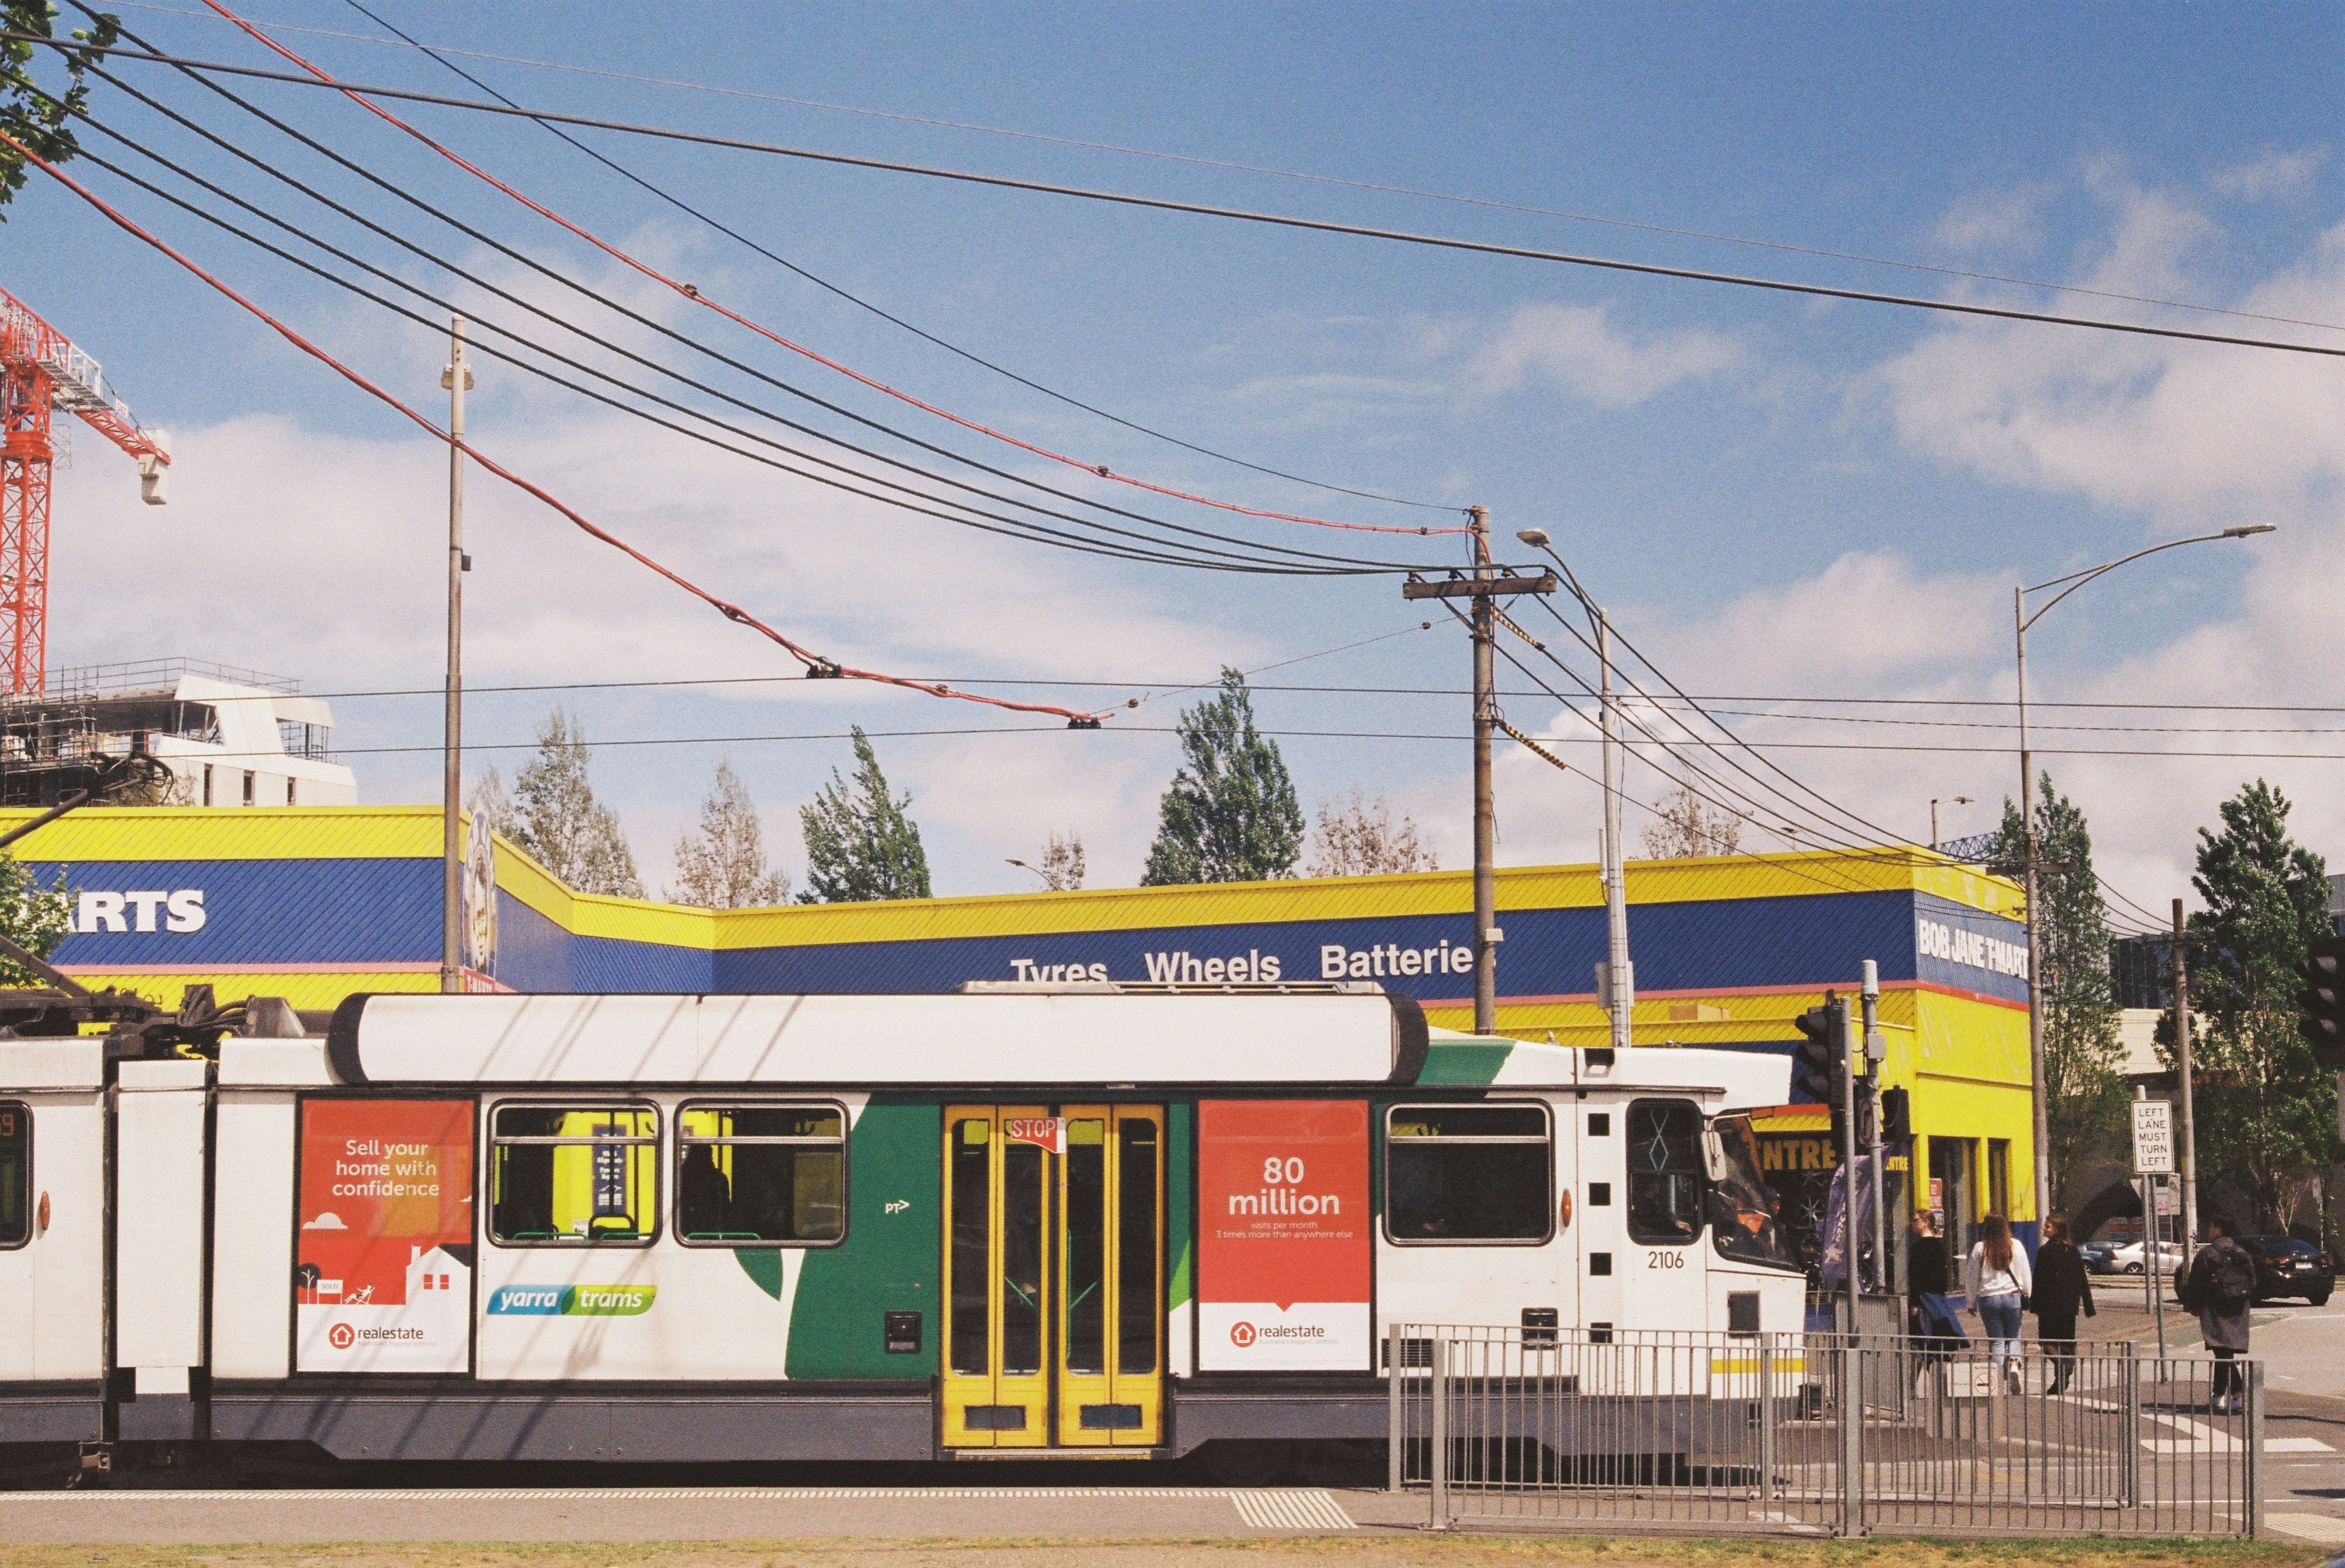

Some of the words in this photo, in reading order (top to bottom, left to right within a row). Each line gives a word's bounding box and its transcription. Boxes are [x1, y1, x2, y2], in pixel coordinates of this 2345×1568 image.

[1919, 919, 1950, 960] BOB
[1951, 928, 1985, 968] JANE
[1010, 959, 1108, 982] Tyres
[1144, 949, 1281, 983] Wheels
[1322, 939, 1496, 978] Batterie
[2139, 1108, 2163, 1116] LEFT
[0, 1113, 14, 1135] 9
[1012, 1120, 1055, 1137] STOP
[2138, 1120, 2166, 1129] LANE
[2139, 1132, 2166, 1141] MUST
[346, 1139, 380, 1156] Sell
[384, 1144, 428, 1159] your
[1758, 1140, 1837, 1170] NTRE
[2141, 1144, 2167, 1153] TURN
[336, 1160, 390, 1176] home
[395, 1160, 437, 1176] with
[2141, 1157, 2166, 1166] LEFT
[1264, 1157, 1304, 1184] 80
[332, 1181, 440, 1196] confidence
[1229, 1188, 1340, 1215] million
[1293, 1231, 1334, 1239] anywhere
[1648, 1251, 1683, 1269] 2106
[500, 1291, 558, 1311] yarra
[581, 1289, 642, 1308] trams
[358, 1327, 424, 1340] realestate
[1259, 1325, 1325, 1337] realestate
